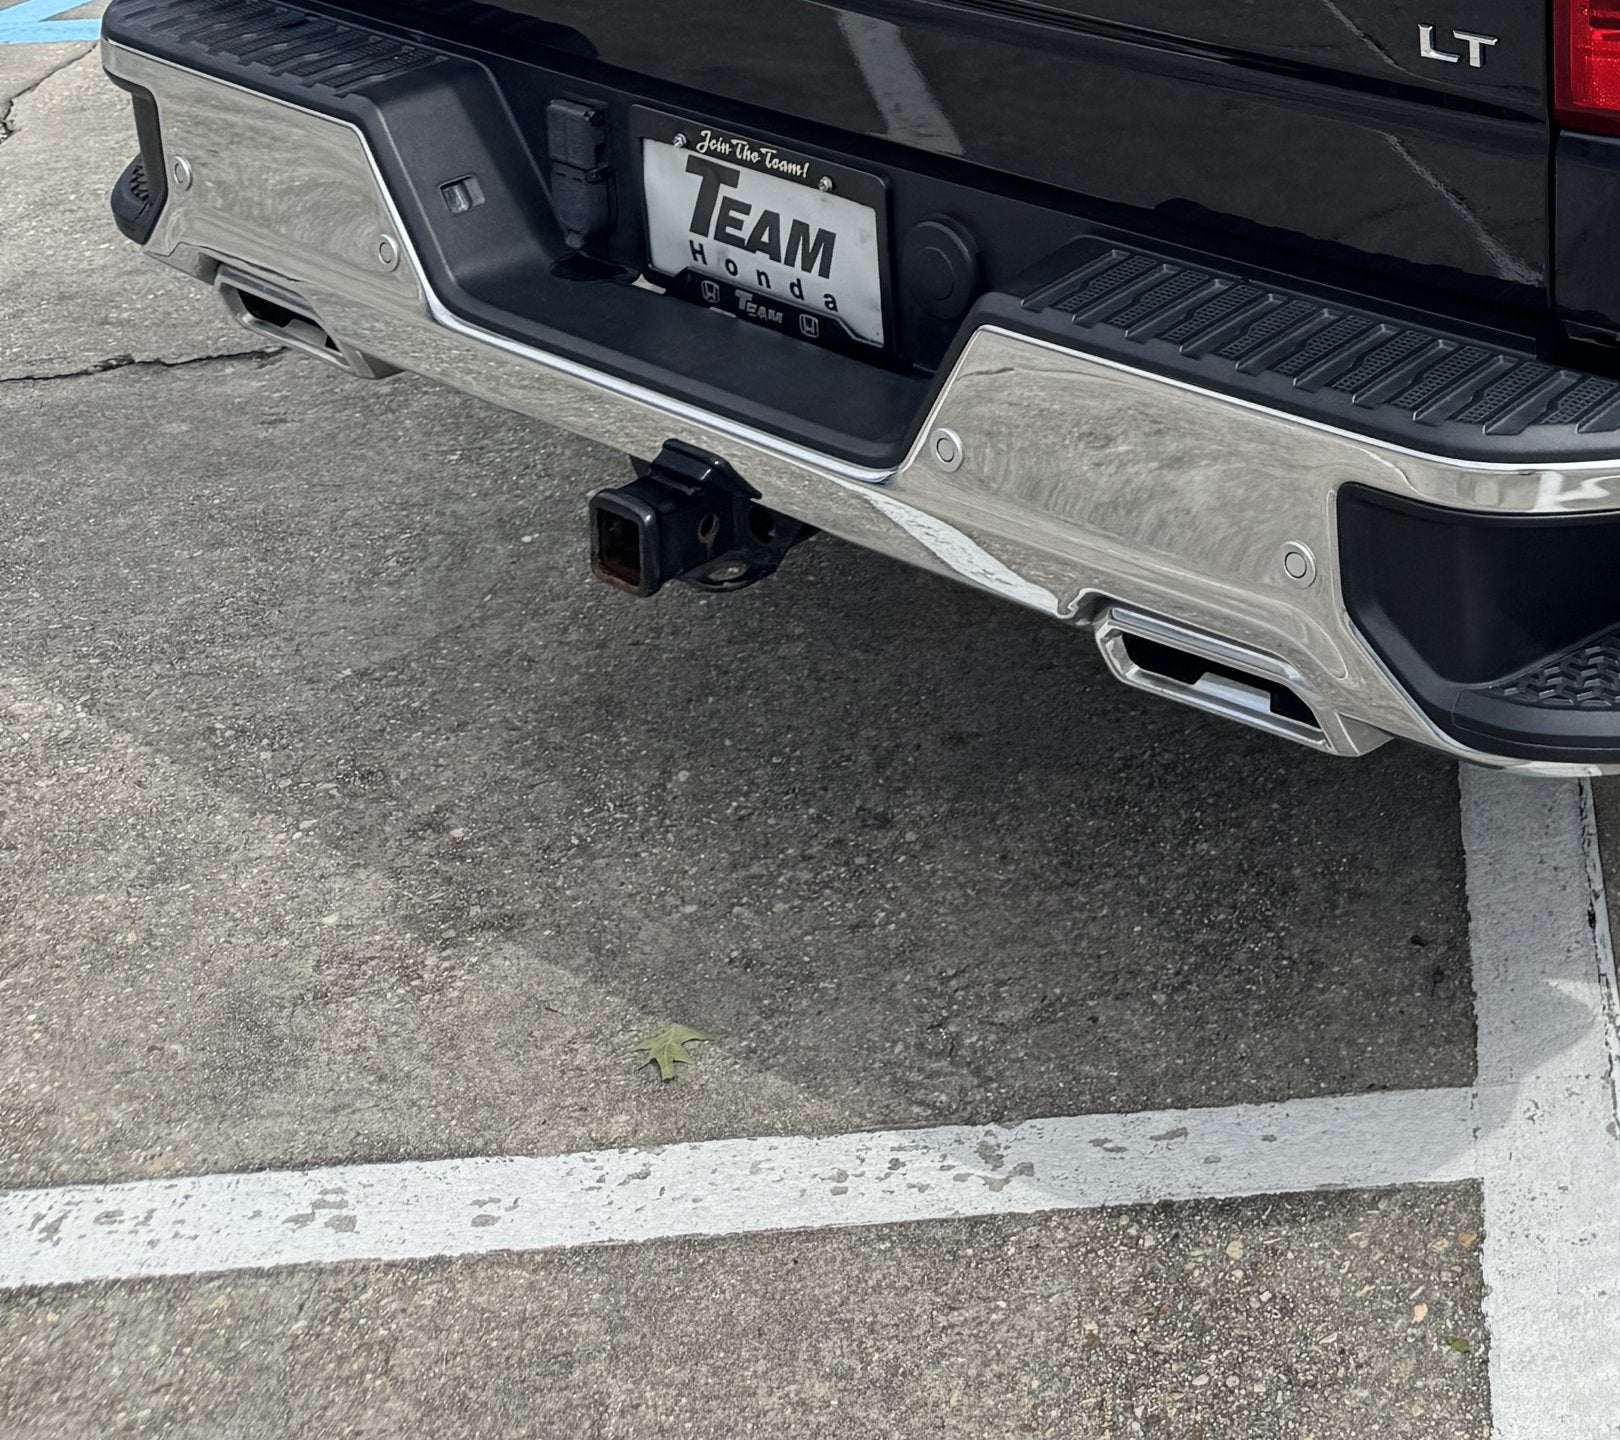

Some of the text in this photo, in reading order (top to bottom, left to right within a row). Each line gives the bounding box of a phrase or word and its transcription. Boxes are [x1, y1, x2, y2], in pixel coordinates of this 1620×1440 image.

[1417, 23, 1499, 68] LT
[696, 130, 810, 178] Join The Team!
[685, 153, 837, 279] TEAM
[688, 239, 838, 313] Honda
[734, 289, 784, 324] TEAM
